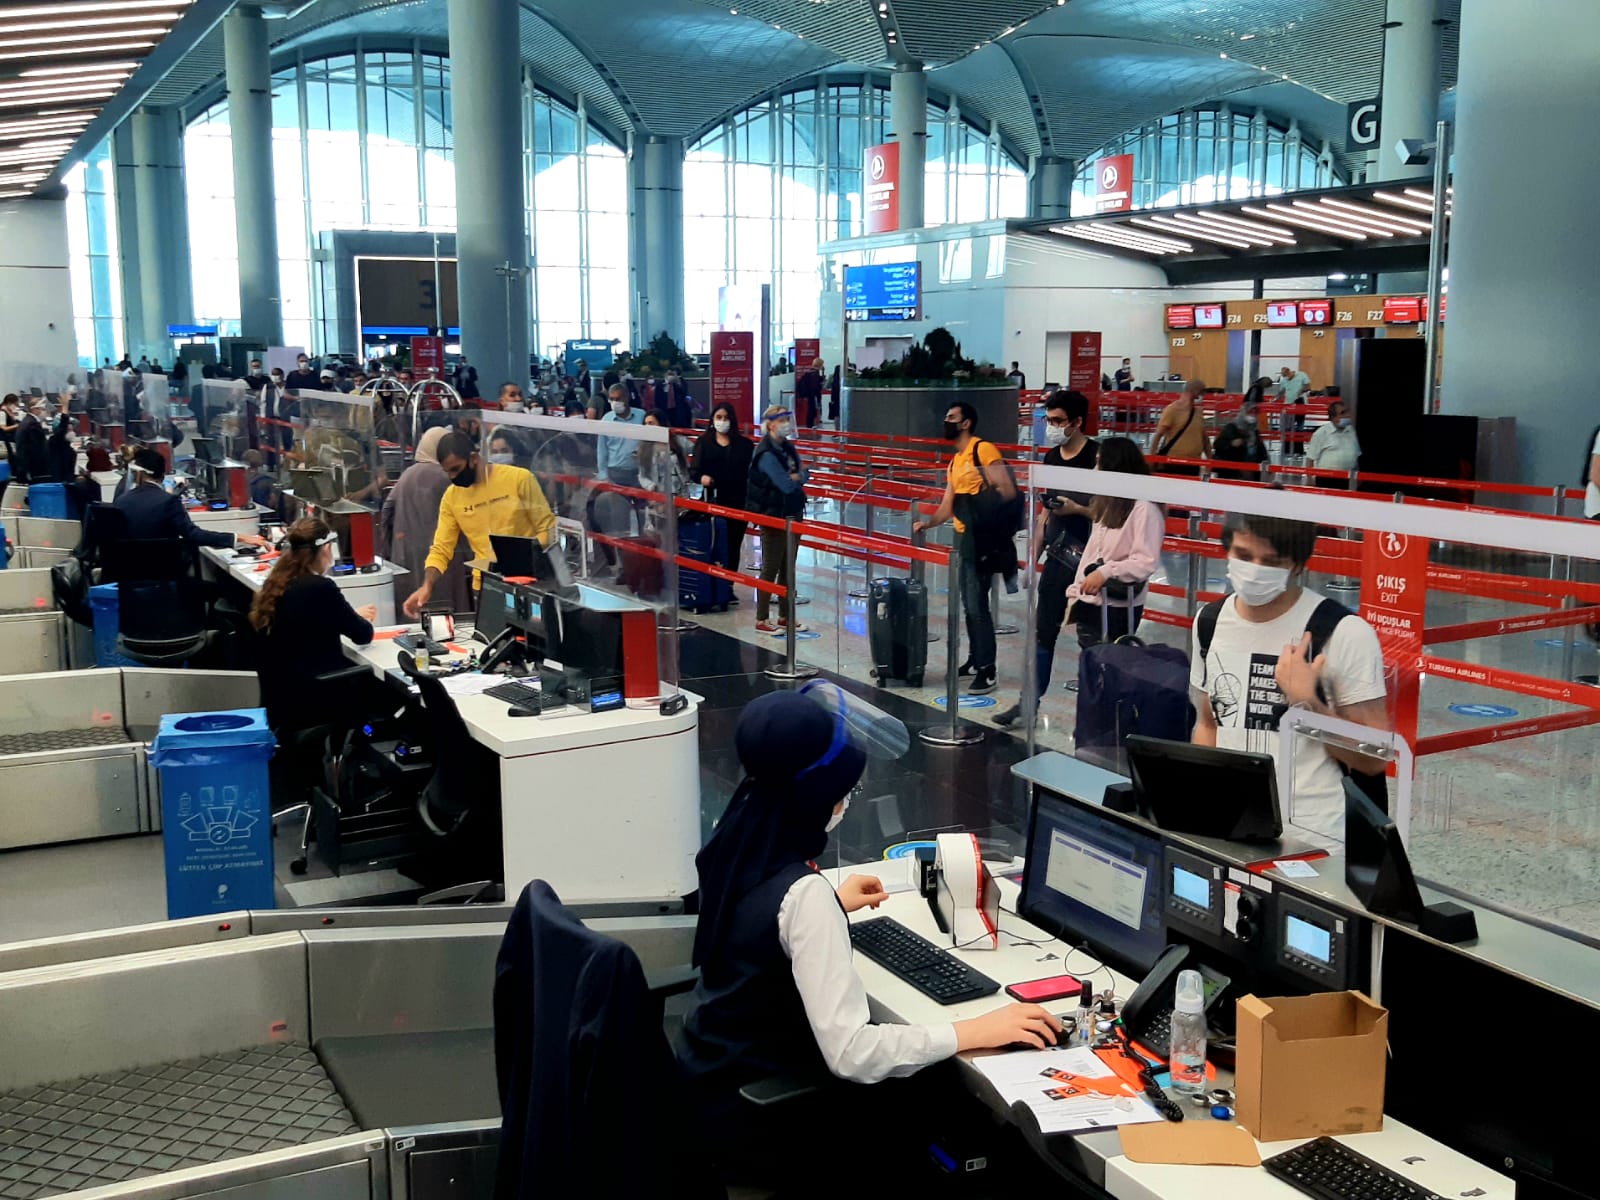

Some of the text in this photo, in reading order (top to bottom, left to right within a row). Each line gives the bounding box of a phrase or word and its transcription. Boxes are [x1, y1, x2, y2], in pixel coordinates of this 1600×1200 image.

[1351, 105, 1377, 144] G
[418, 280, 436, 309] 3
[1227, 314, 1242, 323] F24
[1336, 311, 1353, 321] F26
[1367, 310, 1384, 320] F27
[1376, 574, 1406, 593] ÇIKIŞ
[1380, 592, 1399, 604] EXIT
[1377, 614, 1411, 628] UÇUŞLAR
[1251, 663, 1274, 675] TEAM
[1428, 662, 1456, 674] TURKISH
[1457, 668, 1486, 680] AIRLINES
[1250, 676, 1277, 689] MAKES
[1249, 690, 1265, 701] THE
[1248, 703, 1273, 715] WORK
